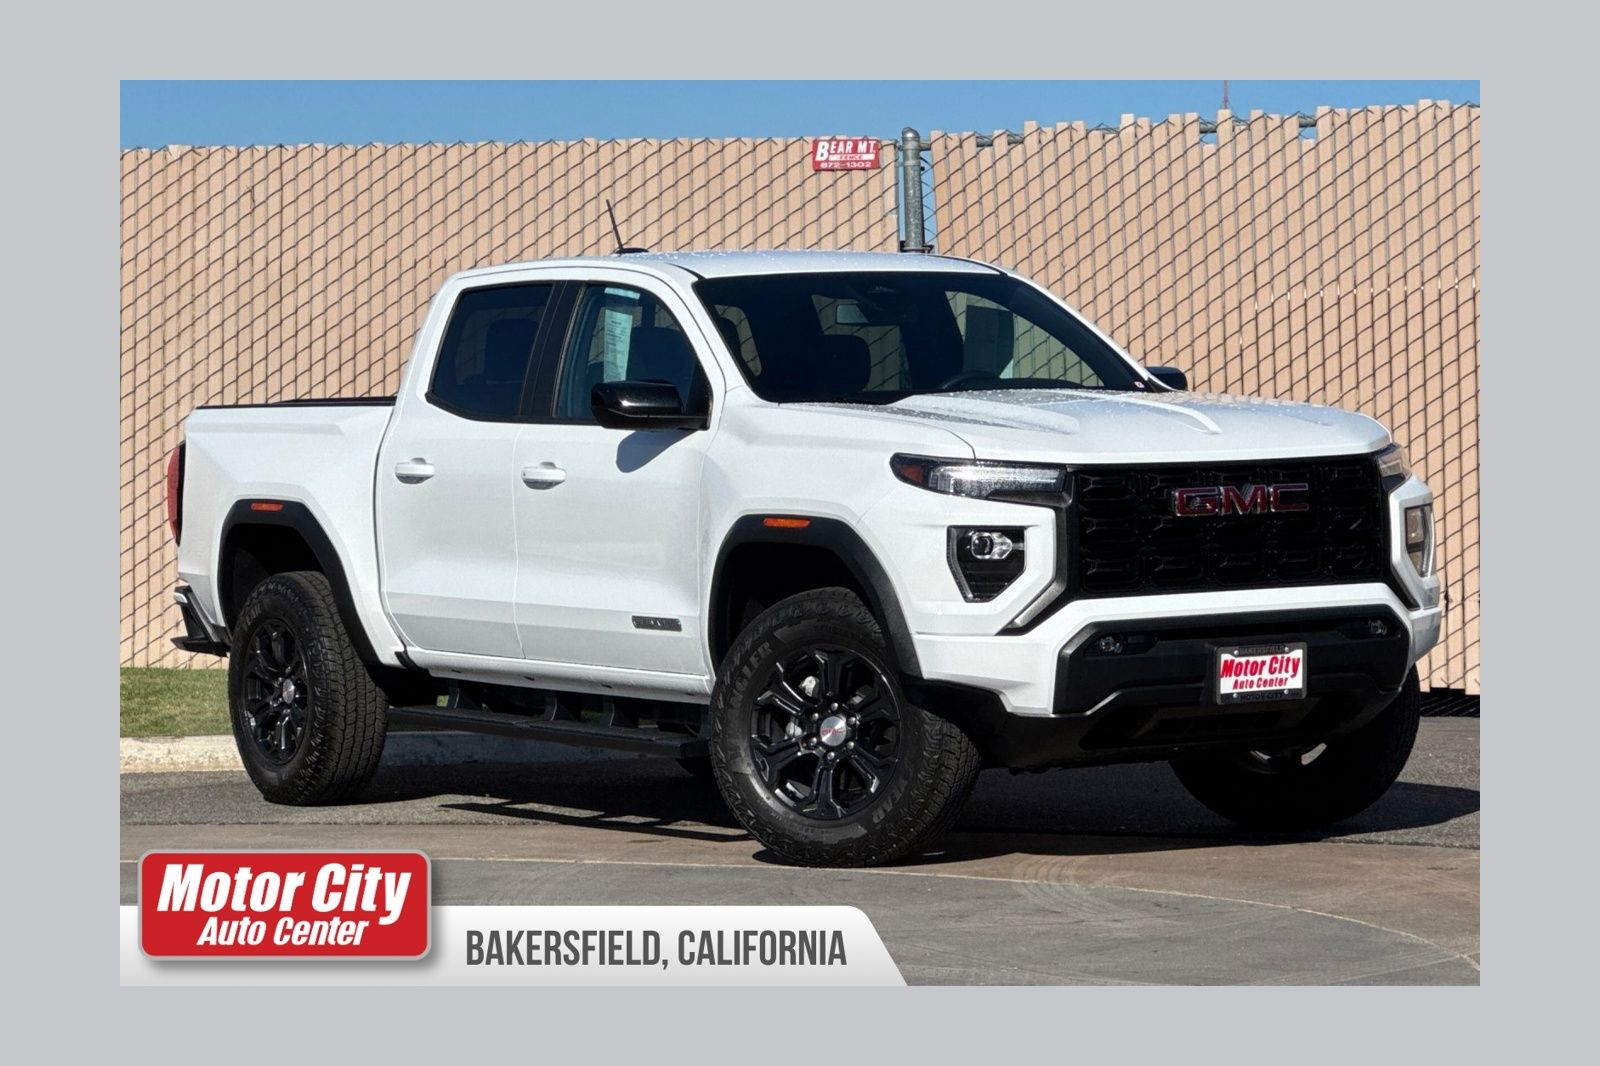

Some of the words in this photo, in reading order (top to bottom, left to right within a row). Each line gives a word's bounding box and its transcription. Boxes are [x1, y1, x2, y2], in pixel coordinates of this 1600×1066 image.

[815, 140, 853, 161] BEAR
[1172, 483, 1309, 517] GMC
[1220, 659, 1266, 679] Motor
[1268, 655, 1301, 678] City
[1232, 678, 1255, 690] Auto
[1256, 676, 1289, 688] Center
